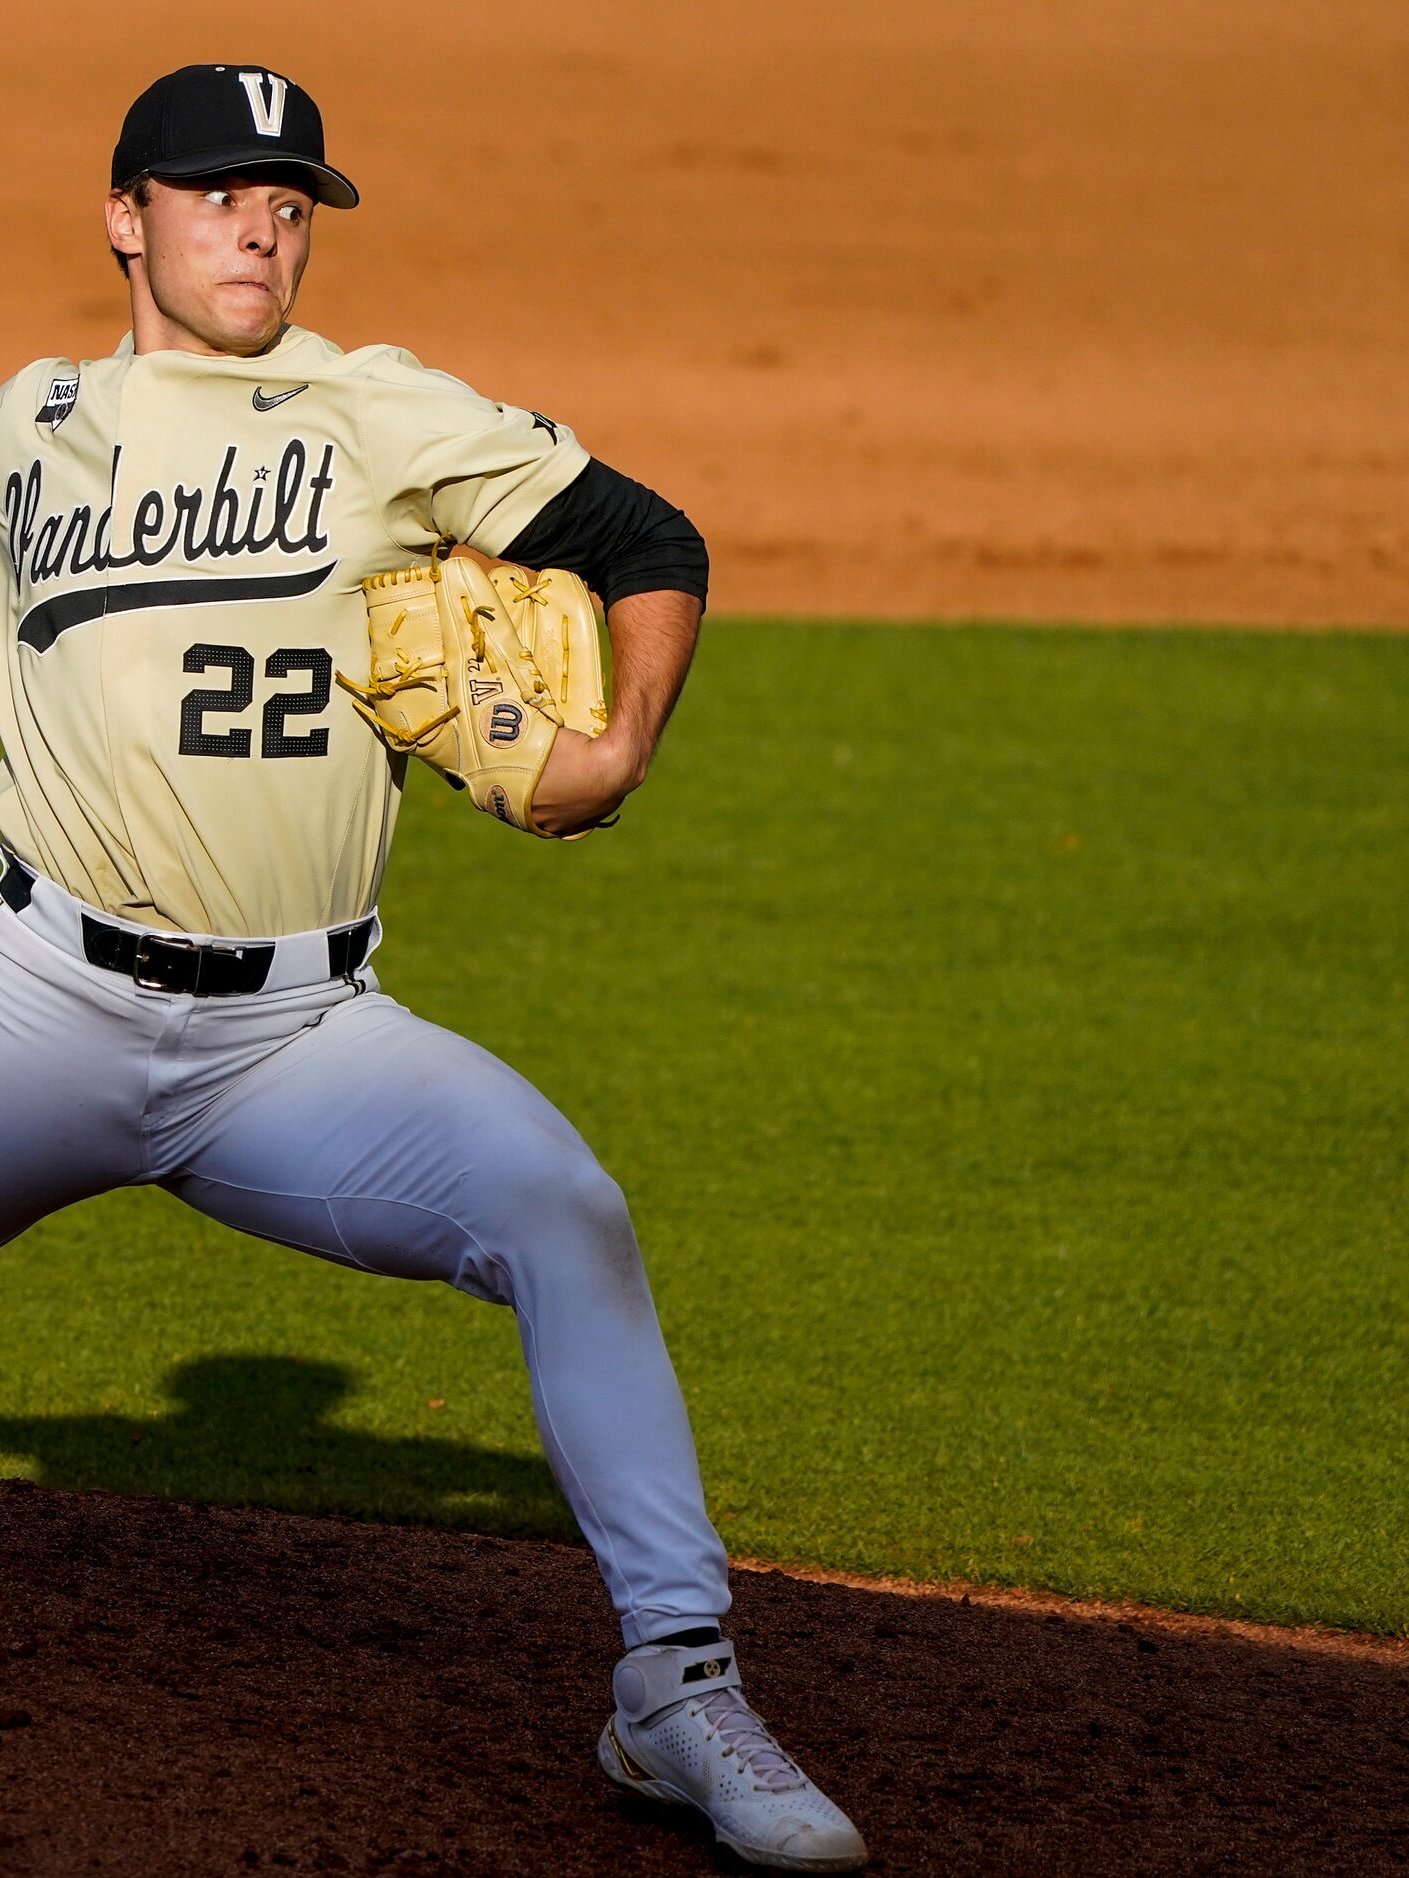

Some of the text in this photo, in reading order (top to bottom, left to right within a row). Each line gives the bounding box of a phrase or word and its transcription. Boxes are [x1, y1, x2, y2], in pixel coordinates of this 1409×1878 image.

[239, 72, 288, 137] V
[4, 438, 334, 598] Vanderbilt
[179, 643, 333, 759] 22
[469, 679, 504, 706] V
